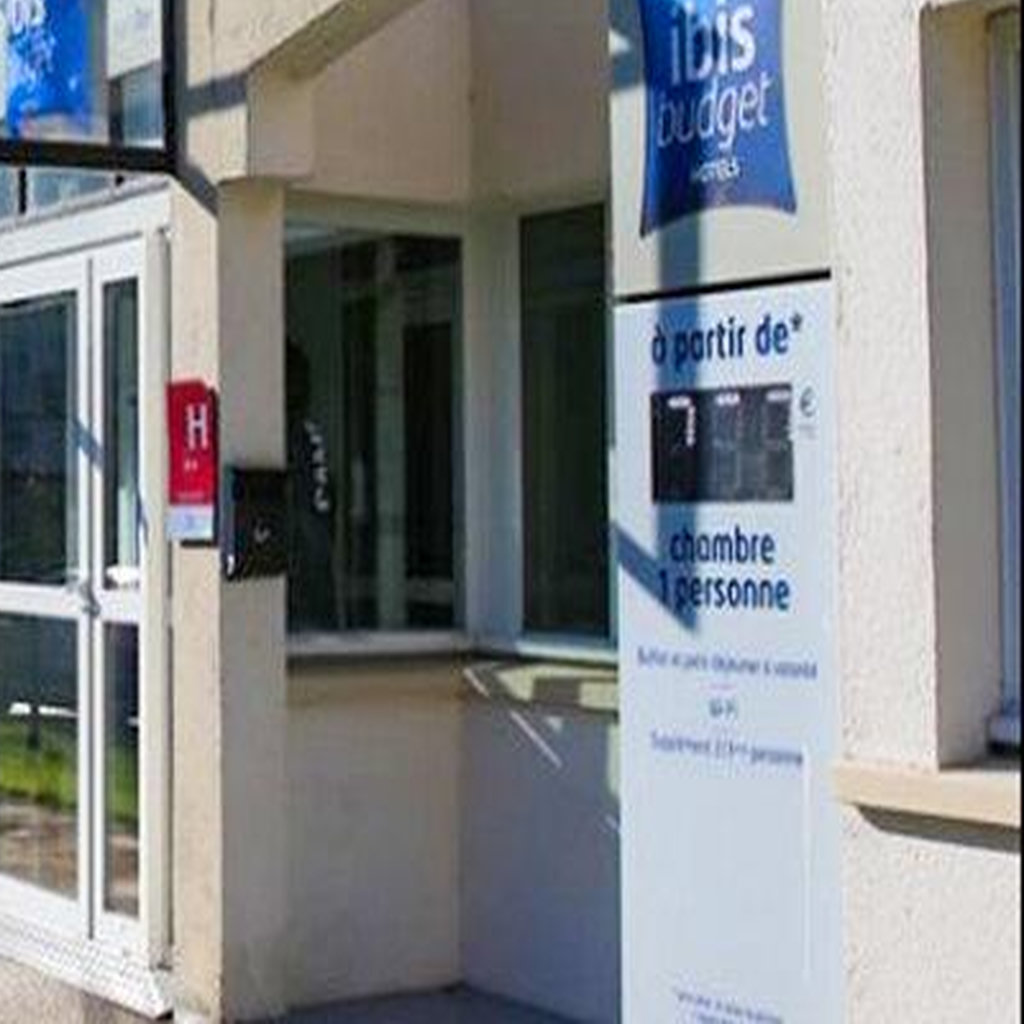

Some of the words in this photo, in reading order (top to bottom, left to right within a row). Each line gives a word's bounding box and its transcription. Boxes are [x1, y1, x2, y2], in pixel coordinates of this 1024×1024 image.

[656, 72, 773, 150] budget
[675, 316, 747, 374] partir
[186, 403, 209, 451] H
[669, 525, 776, 564] chambre
[658, 569, 669, 605] 1
[675, 576, 791, 612] personne
